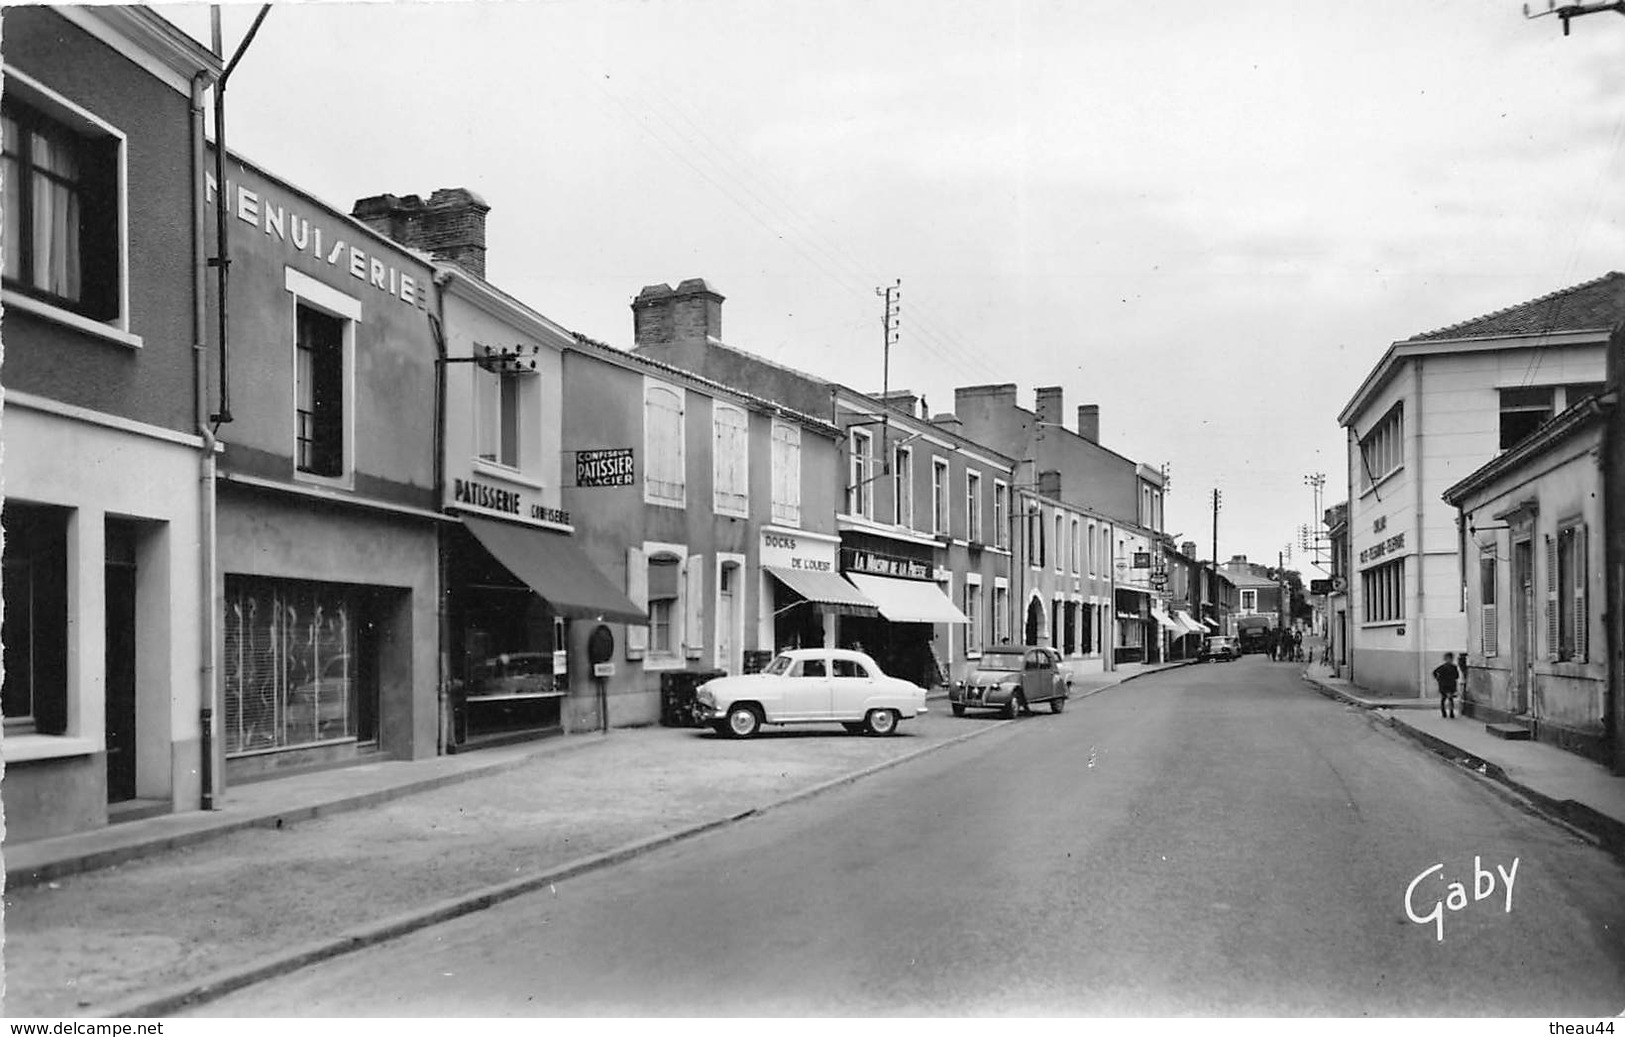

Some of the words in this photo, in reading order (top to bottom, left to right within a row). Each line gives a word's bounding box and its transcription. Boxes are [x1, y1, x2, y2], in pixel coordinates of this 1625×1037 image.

[578, 456, 633, 480] PATISSIER
[455, 478, 521, 515] PATISSERIE
[765, 535, 796, 550] DOCKS
[792, 557, 802, 569] DE
